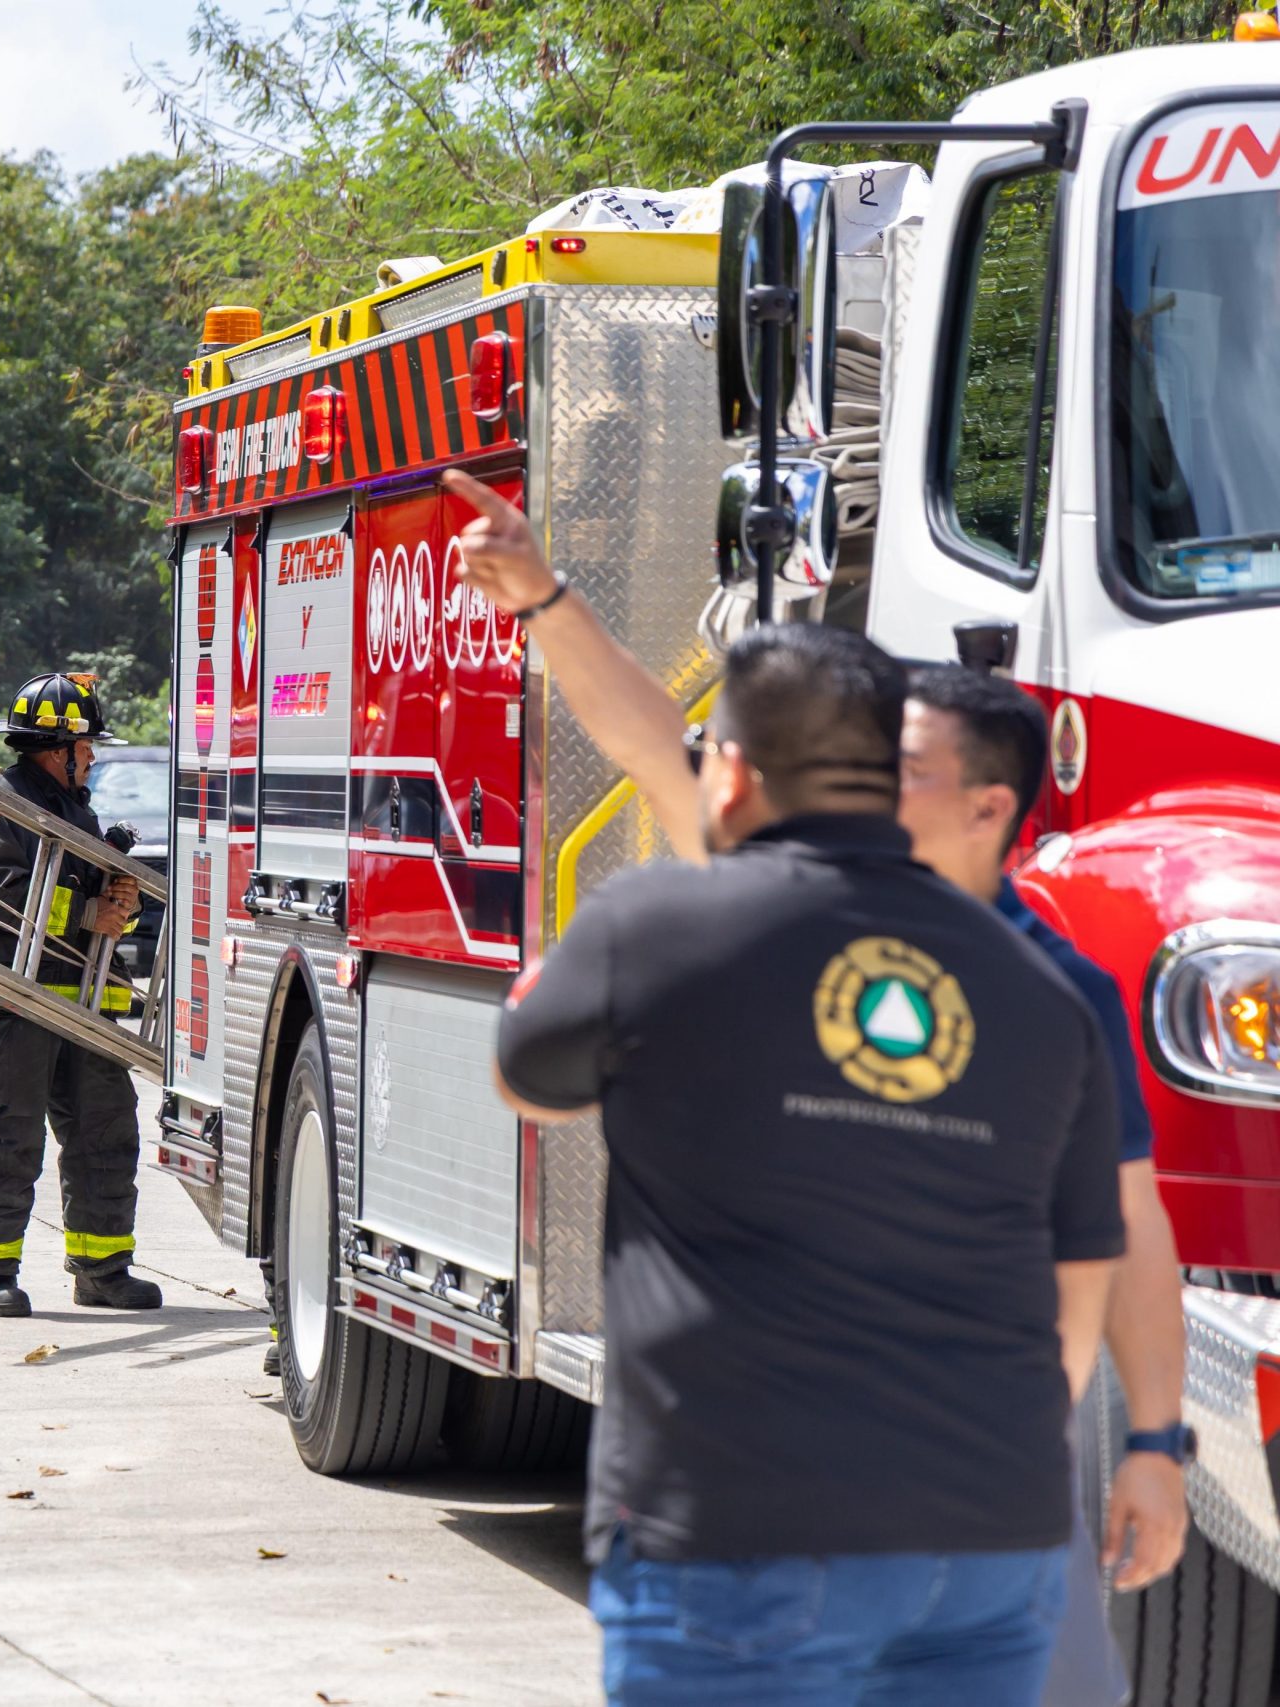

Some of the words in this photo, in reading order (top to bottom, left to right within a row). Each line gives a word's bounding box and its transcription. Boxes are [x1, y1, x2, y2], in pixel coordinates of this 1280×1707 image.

[244, 420, 265, 477] FIRE
[265, 409, 301, 472] TRUCKS
[302, 605, 313, 650] Y
